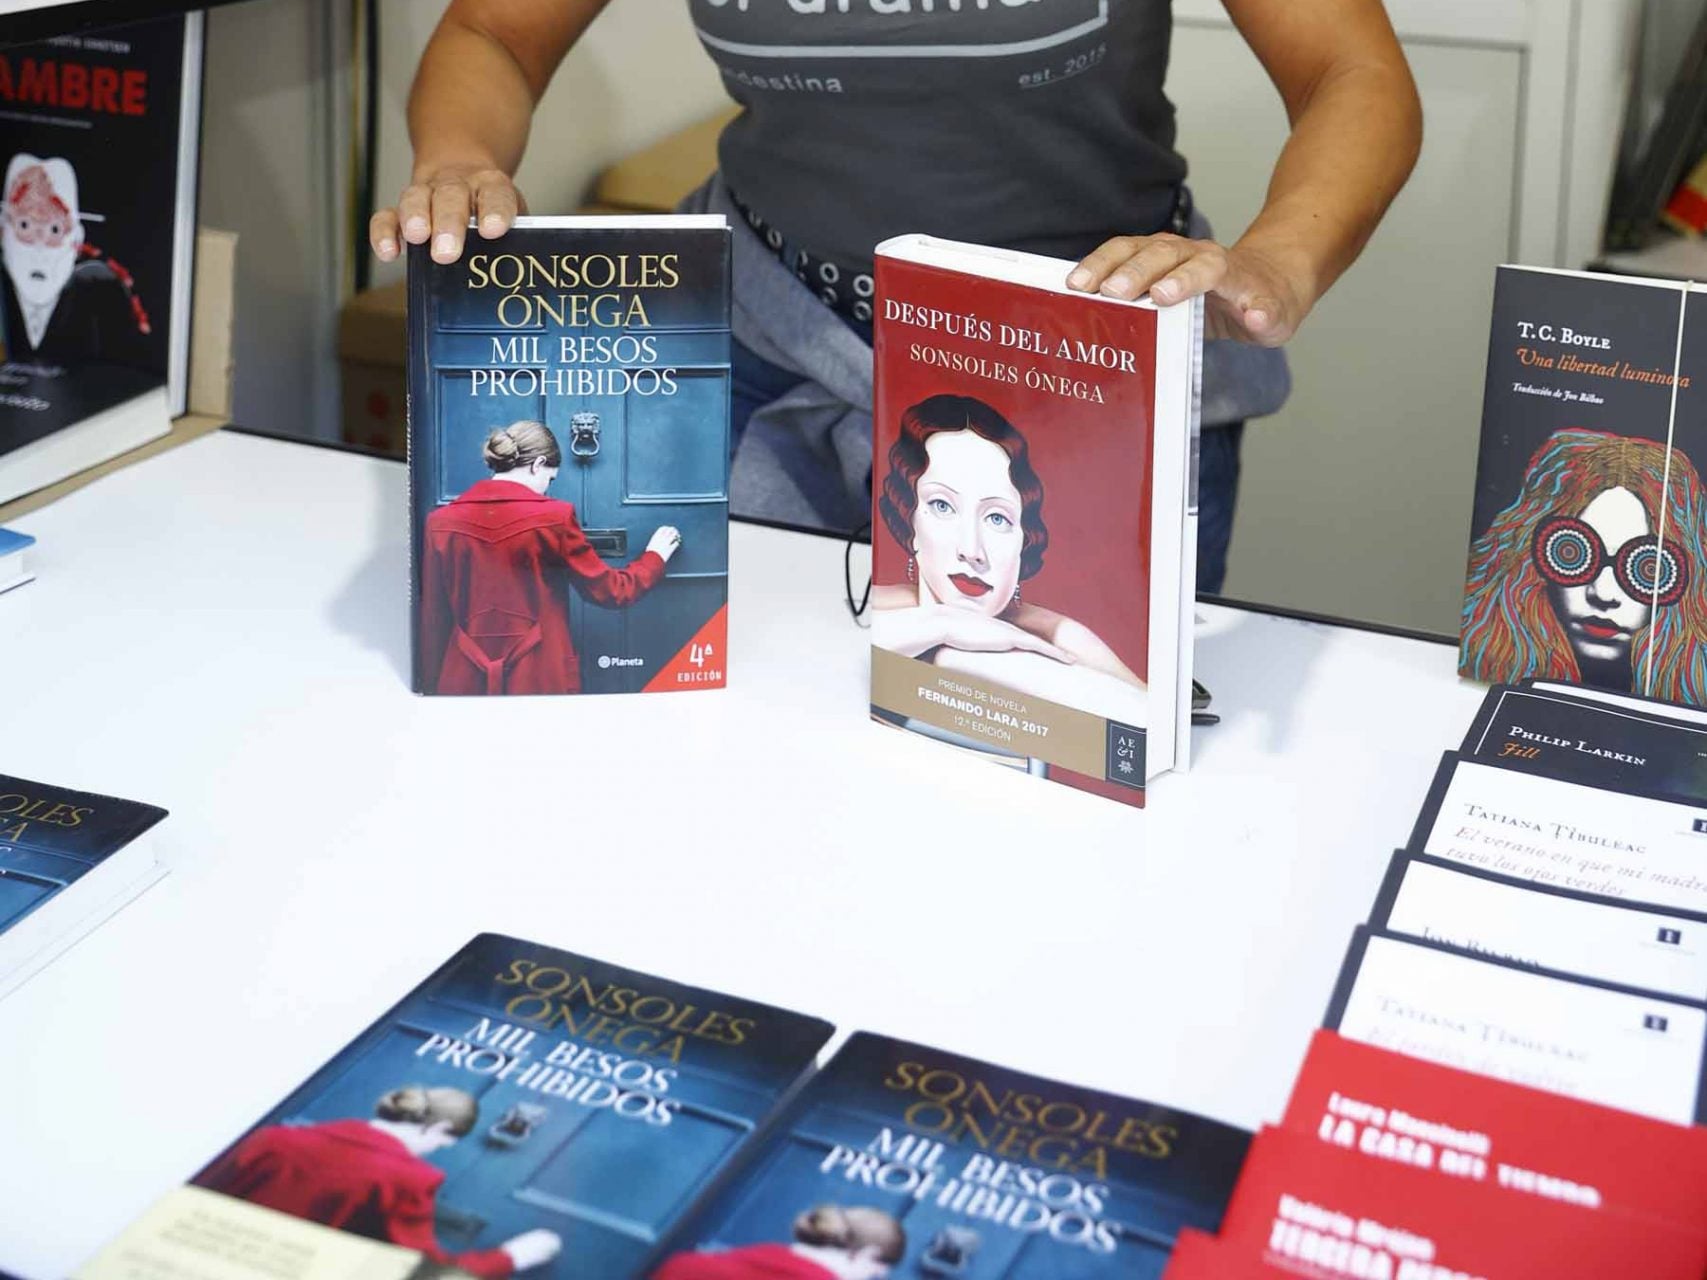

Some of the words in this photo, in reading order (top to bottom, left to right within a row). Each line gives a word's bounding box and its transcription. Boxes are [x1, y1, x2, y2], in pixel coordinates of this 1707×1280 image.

[467, 253, 680, 290] SONSOLES
[496, 285, 652, 328] ÓNEGA
[489, 336, 547, 365] MIL
[559, 335, 658, 365] BESOS
[884, 298, 993, 343] DESPUÉS
[999, 324, 1049, 356] DEL
[1055, 342, 1137, 373] AMOR
[1517, 320, 1556, 342] T.C.
[469, 368, 678, 397] PROHIBIDOS
[909, 342, 1019, 385] SONSOLES
[1024, 366, 1105, 405] ÓNEGA
[1516, 346, 1554, 368] Una
[1557, 354, 1620, 379] libertad
[1620, 362, 1691, 389] luminoa
[611, 656, 644, 667] Planeta
[677, 670, 722, 683] EDICIÓN
[917, 686, 984, 717] FERNANDO
[986, 708, 1019, 729] LARA
[1021, 720, 1049, 737] 2017
[938, 678, 973, 697] PREMIO
[974, 690, 987, 702] DE
[989, 694, 1027, 714] NOVELA
[972, 721, 1011, 742] EDICIÓN
[1508, 725, 1572, 749] PHILIP
[1574, 740, 1648, 766] LARKIN
[1463, 802, 1542, 833] TATIANA
[1455, 826, 1481, 841] El
[1483, 835, 1547, 858] verano
[1550, 850, 1574, 864] en
[1577, 856, 1613, 874] que
[494, 957, 759, 1048] SONSOLES
[463, 1017, 537, 1058] MIL
[545, 1040, 679, 1095] BESOS
[415, 1032, 684, 1127] PROHIBIDOS
[884, 1060, 1179, 1160] SONSOLES
[866, 1127, 945, 1172] MIL
[960, 1154, 1110, 1215] BESOS
[820, 1145, 1124, 1255] PROHIBIDOS
